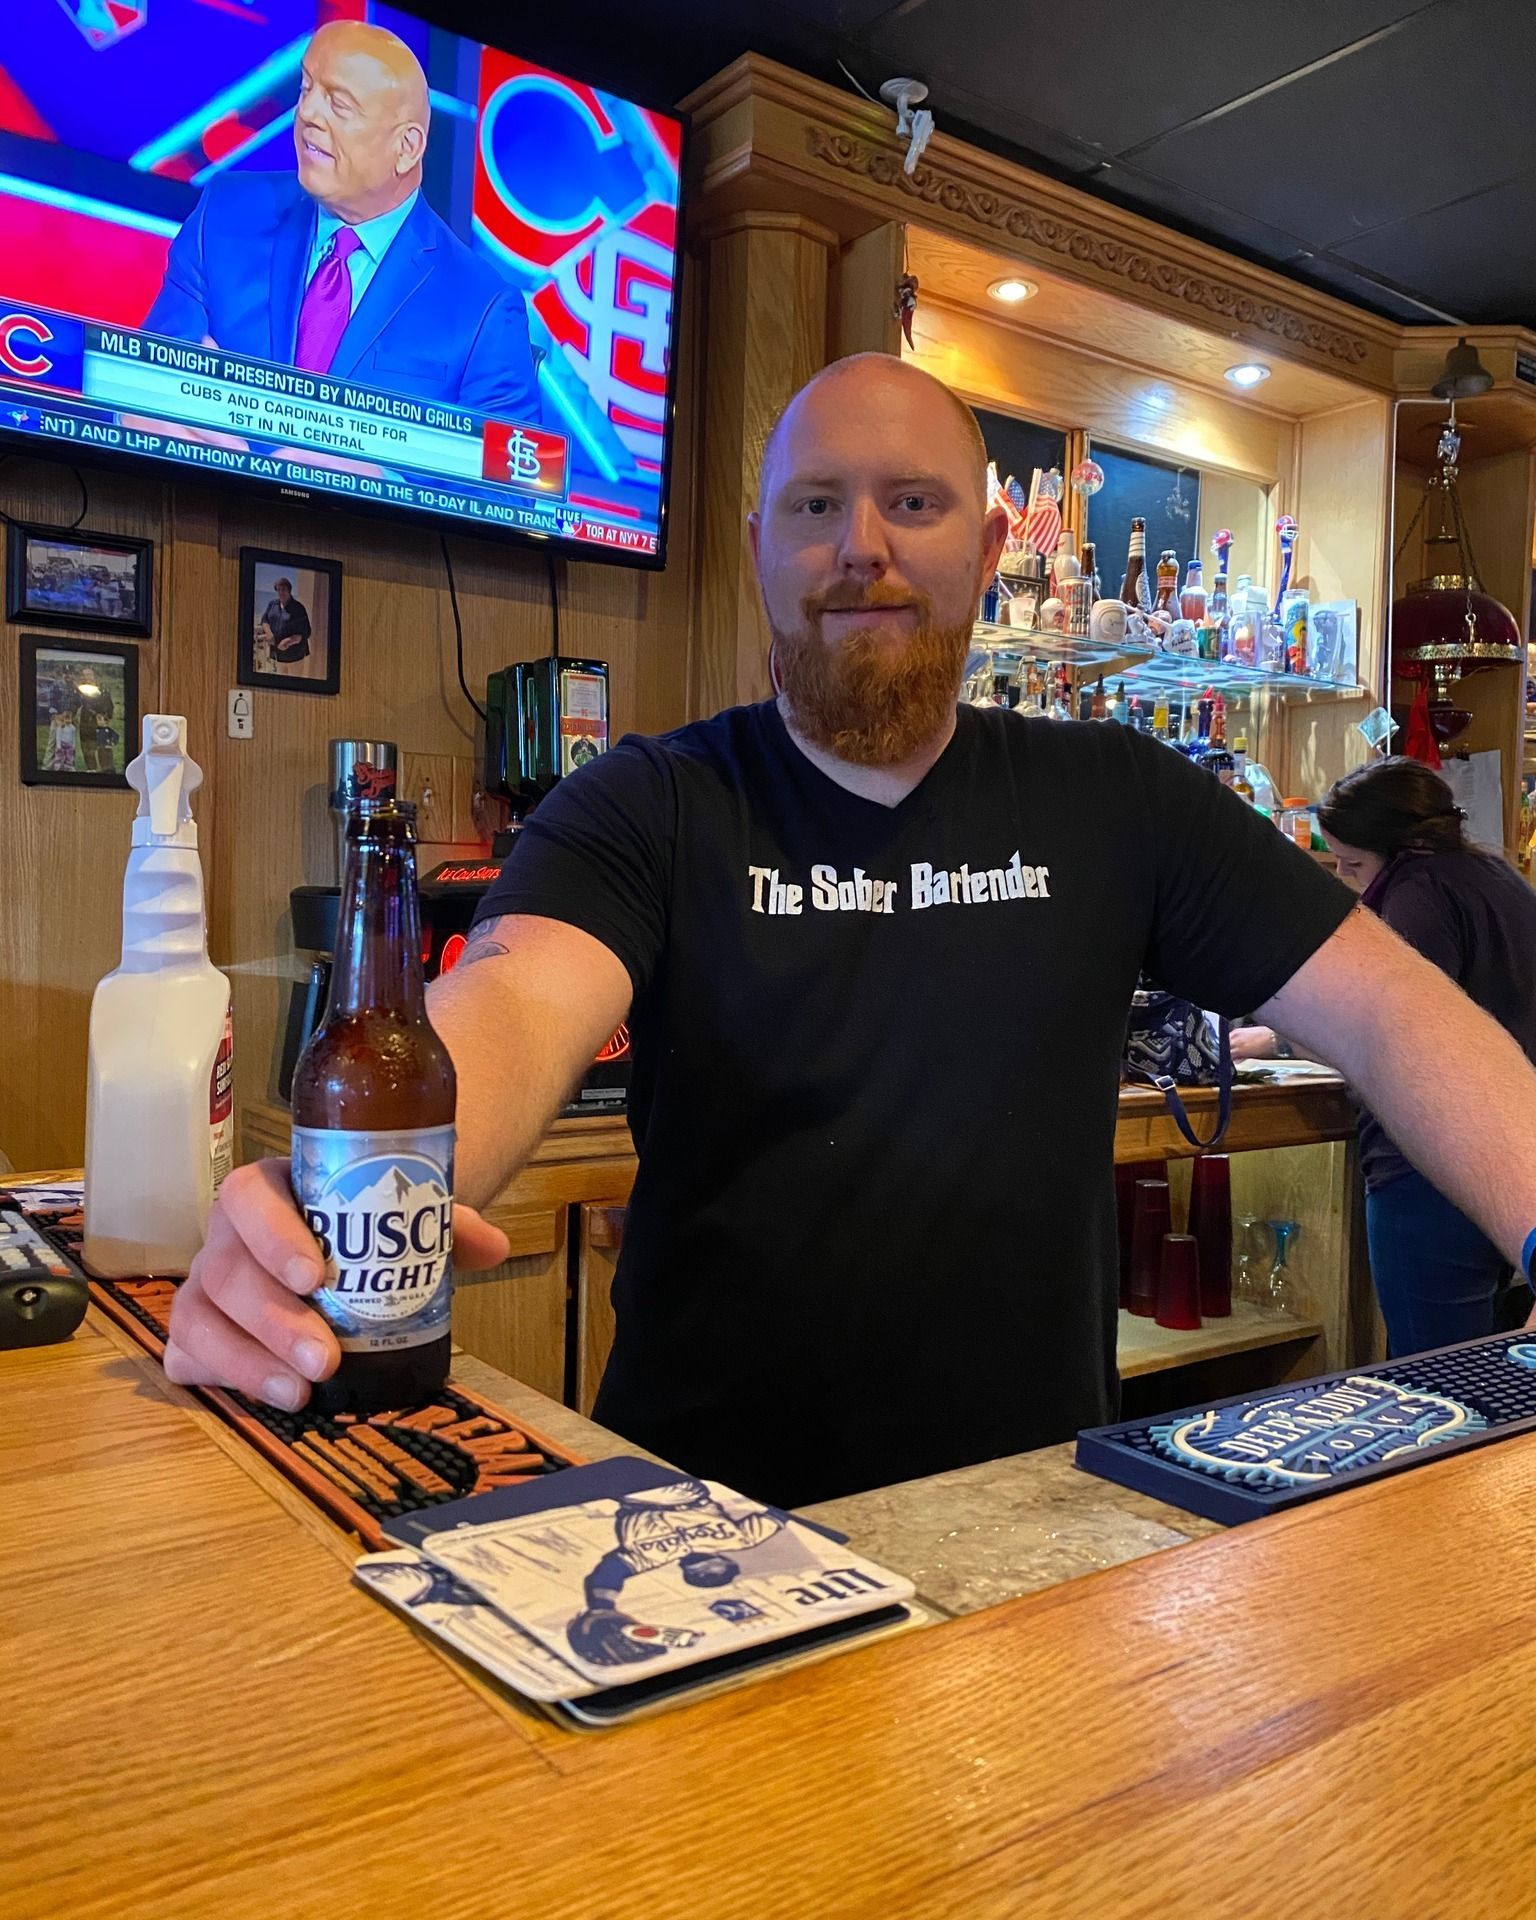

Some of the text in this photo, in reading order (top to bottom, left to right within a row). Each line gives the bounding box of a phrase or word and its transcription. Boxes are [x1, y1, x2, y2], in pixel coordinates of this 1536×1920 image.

[100, 331, 472, 432] MLB TONIGHT PRESENTED BY NAPOLEON GRILLS
[180, 381, 407, 442] CUBS AND CARDINALS TIED FOR
[228, 411, 365, 450] 1ST IN NL CENTRAL
[81, 424, 119, 444] AND
[126, 434, 161, 451] LHP
[165, 441, 245, 468] ANTHONY
[250, 457, 284, 476] KAY
[286, 463, 356, 490] (BLISTER)
[360, 480, 382, 495] ON
[386, 484, 413, 500] THE
[417, 489, 466, 512] 10-DAY
[469, 502, 481, 515] IL
[485, 504, 514, 520] AND
[280, 488, 310, 499] SAMSUNG
[556, 508, 580, 523] LIVE
[586, 523, 604, 539] TOR
[606, 527, 618, 542] AT
[619, 531, 640, 545] NYY
[641, 535, 648, 548] 7
[748, 849, 1051, 915] The Sober Bartender
[335, 1260, 438, 1293] LIGHT
[370, 1339, 379, 1347] 12
[1218, 1416, 1312, 1459] DEEP
[1294, 1384, 1382, 1424] EDDY
[1305, 1404, 1424, 1462] VODKA
[639, 1521, 736, 1554] Royals
[786, 1567, 890, 1606] Lite
